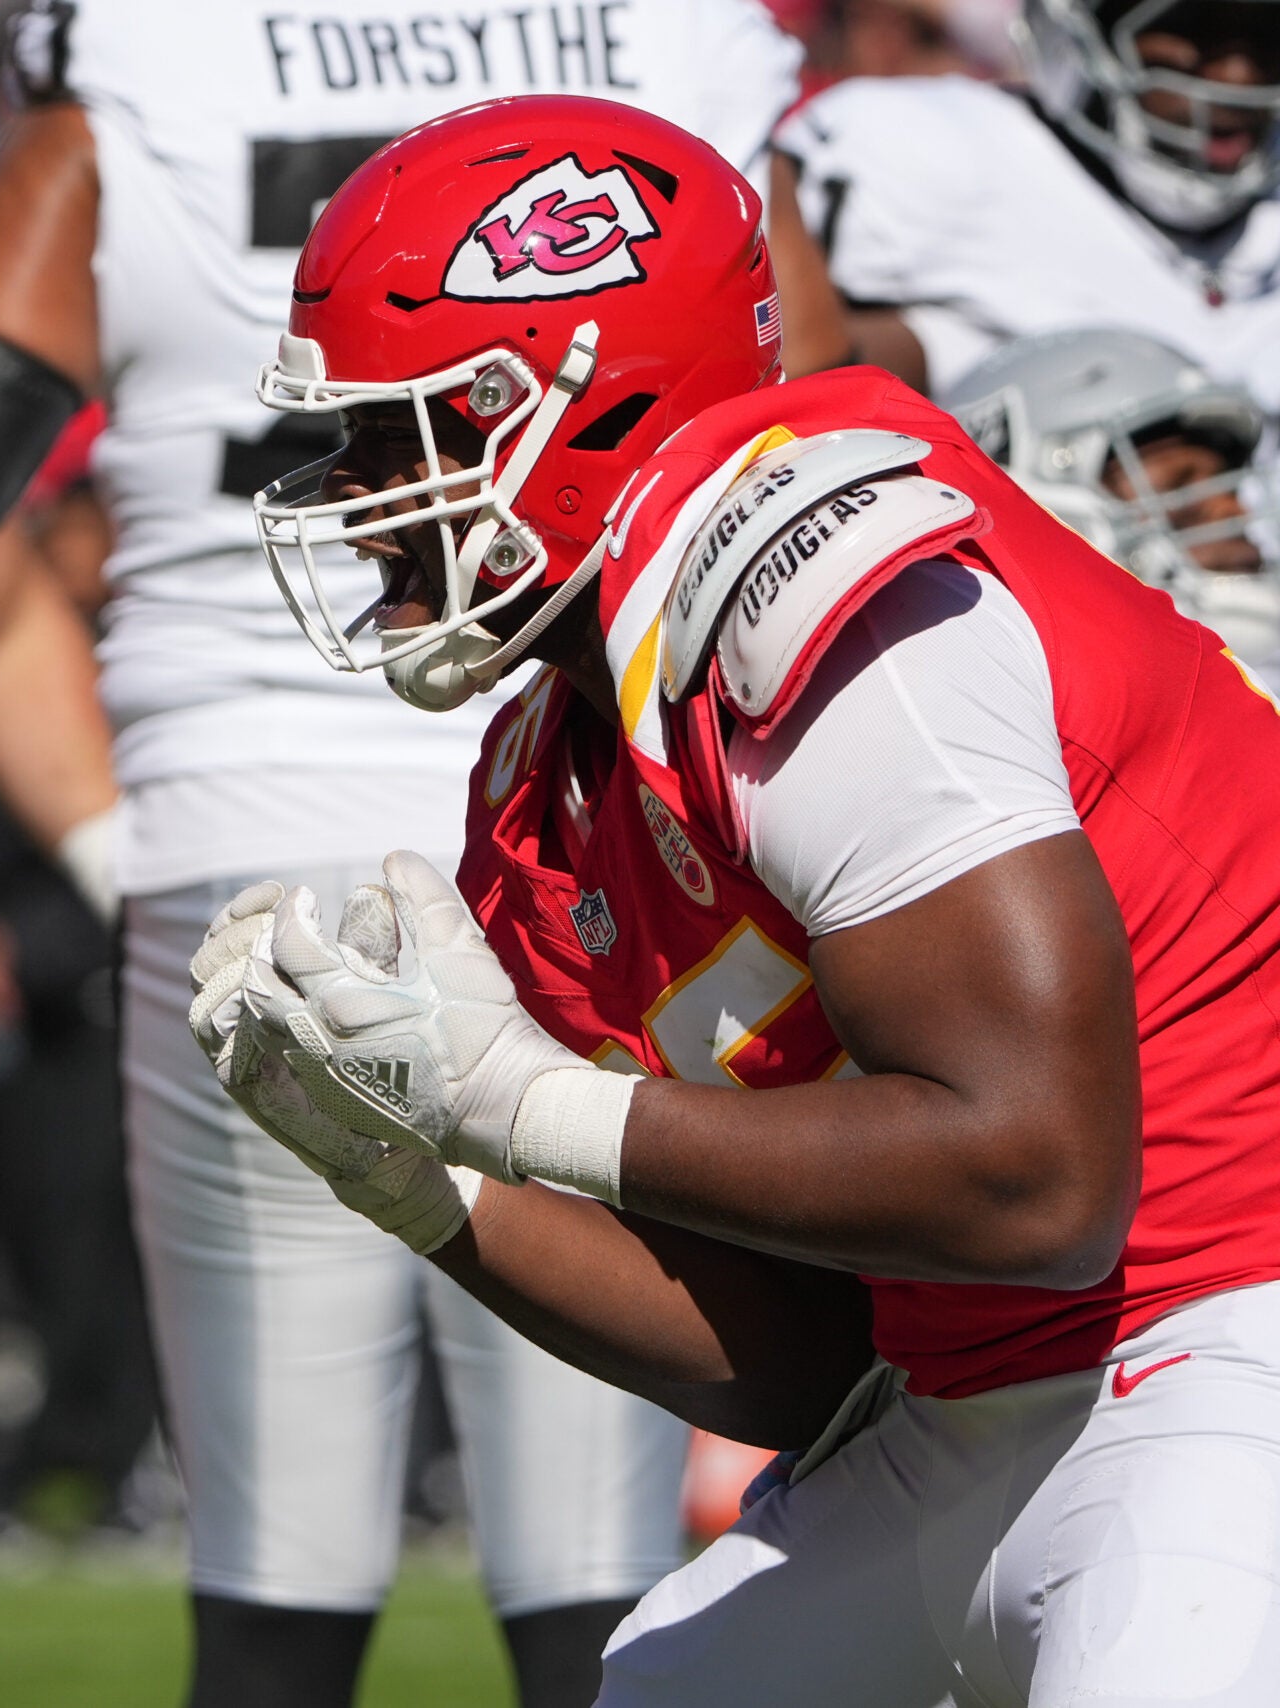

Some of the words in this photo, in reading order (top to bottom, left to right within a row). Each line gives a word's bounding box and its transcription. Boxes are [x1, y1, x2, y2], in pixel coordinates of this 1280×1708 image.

[265, 3, 637, 94] FORSYTHE
[473, 189, 628, 282] KC
[739, 484, 878, 629] DOUGLAS
[581, 917, 612, 946] NFL
[343, 1061, 412, 1114] adidas
